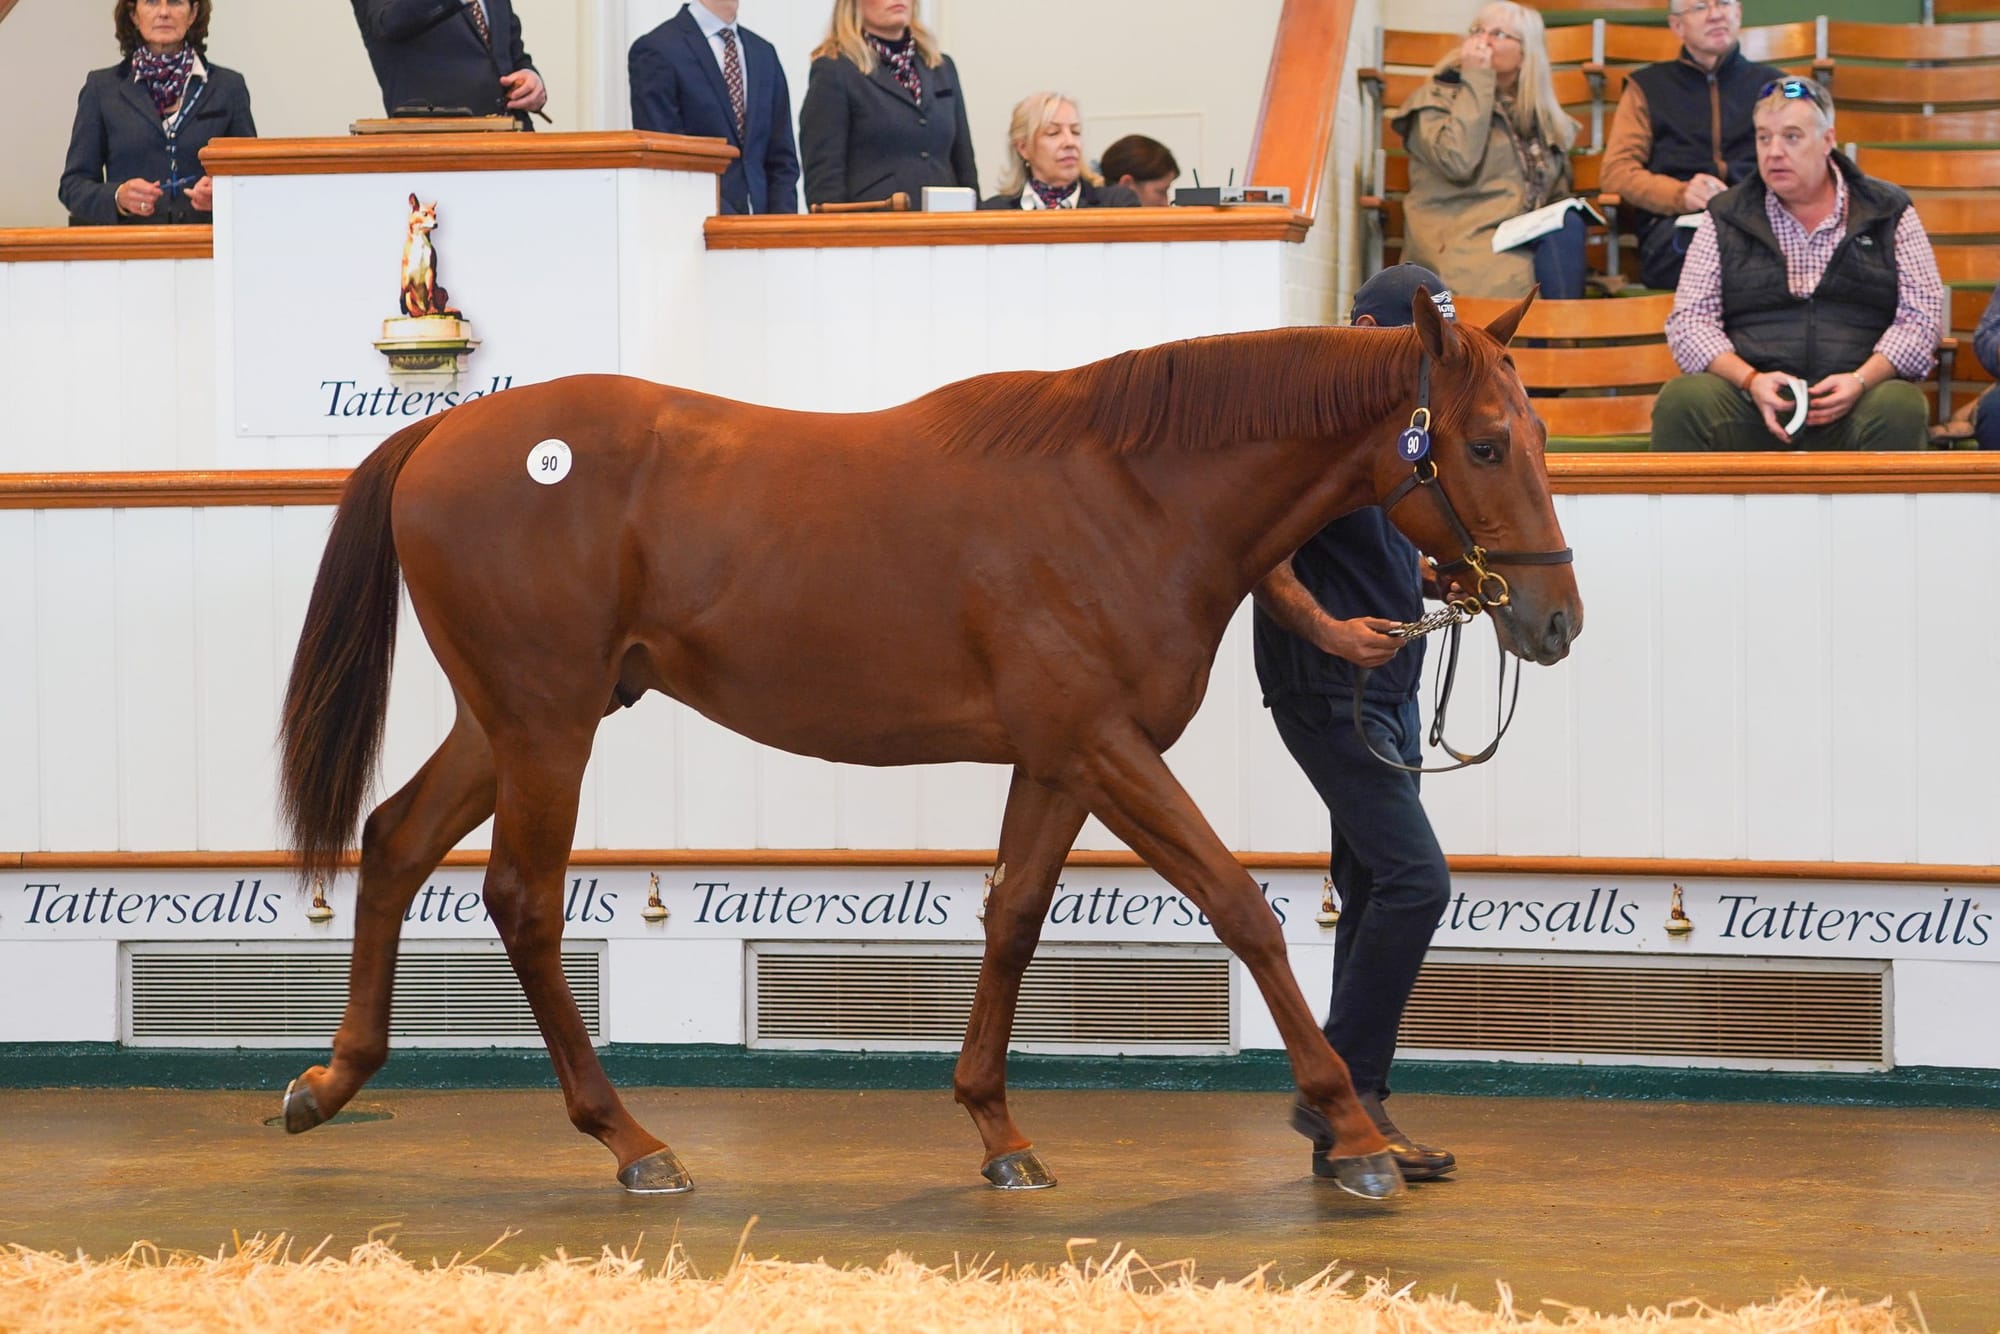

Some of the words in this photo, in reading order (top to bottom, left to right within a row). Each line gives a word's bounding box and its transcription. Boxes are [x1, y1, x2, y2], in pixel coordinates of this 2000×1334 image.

[541, 455, 558, 471] 90
[1407, 435, 1419, 454] 90
[24, 879, 281, 924] Tattersalls
[693, 880, 951, 925] Tattersalls
[1435, 888, 1639, 935] tersalls
[1718, 895, 1993, 946] Tattersalls
